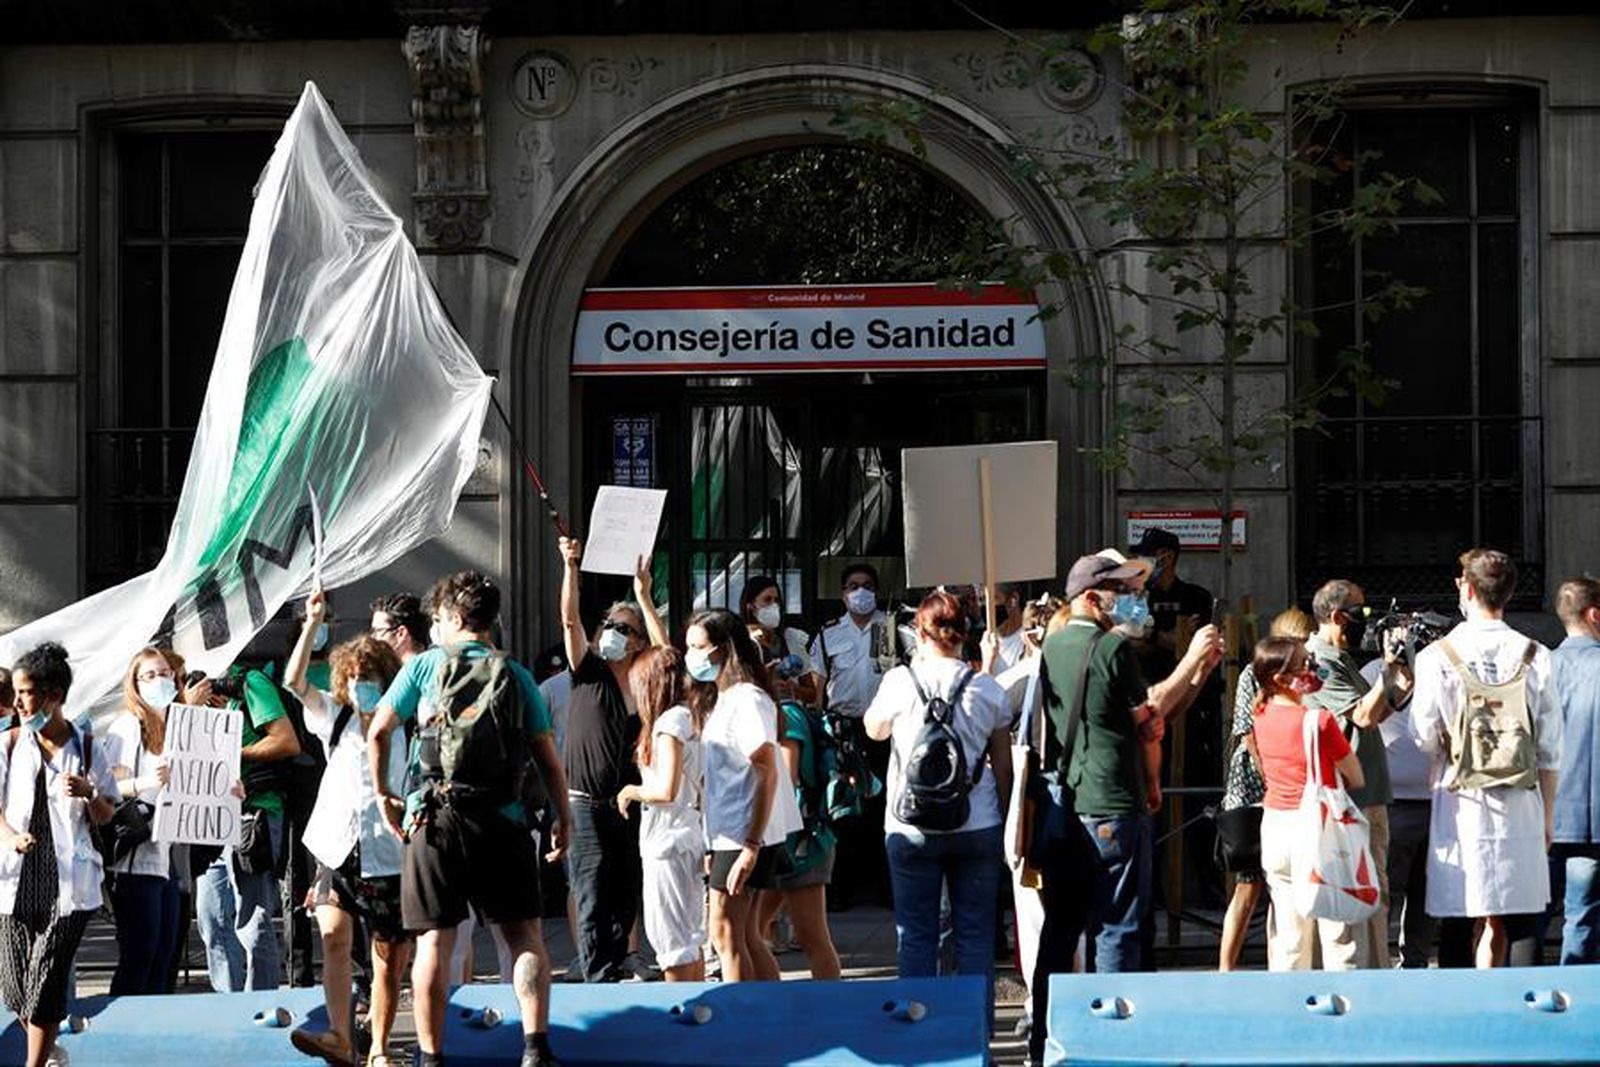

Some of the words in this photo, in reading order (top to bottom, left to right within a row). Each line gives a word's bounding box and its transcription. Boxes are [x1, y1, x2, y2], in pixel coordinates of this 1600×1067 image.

[767, 293, 819, 302] Comunidad
[820, 293, 832, 302] de
[834, 292, 866, 301] Madrid
[604, 321, 799, 357] Consejería
[810, 320, 855, 350] de
[866, 317, 1015, 349] Sanidad
[176, 802, 235, 841] FOUND
